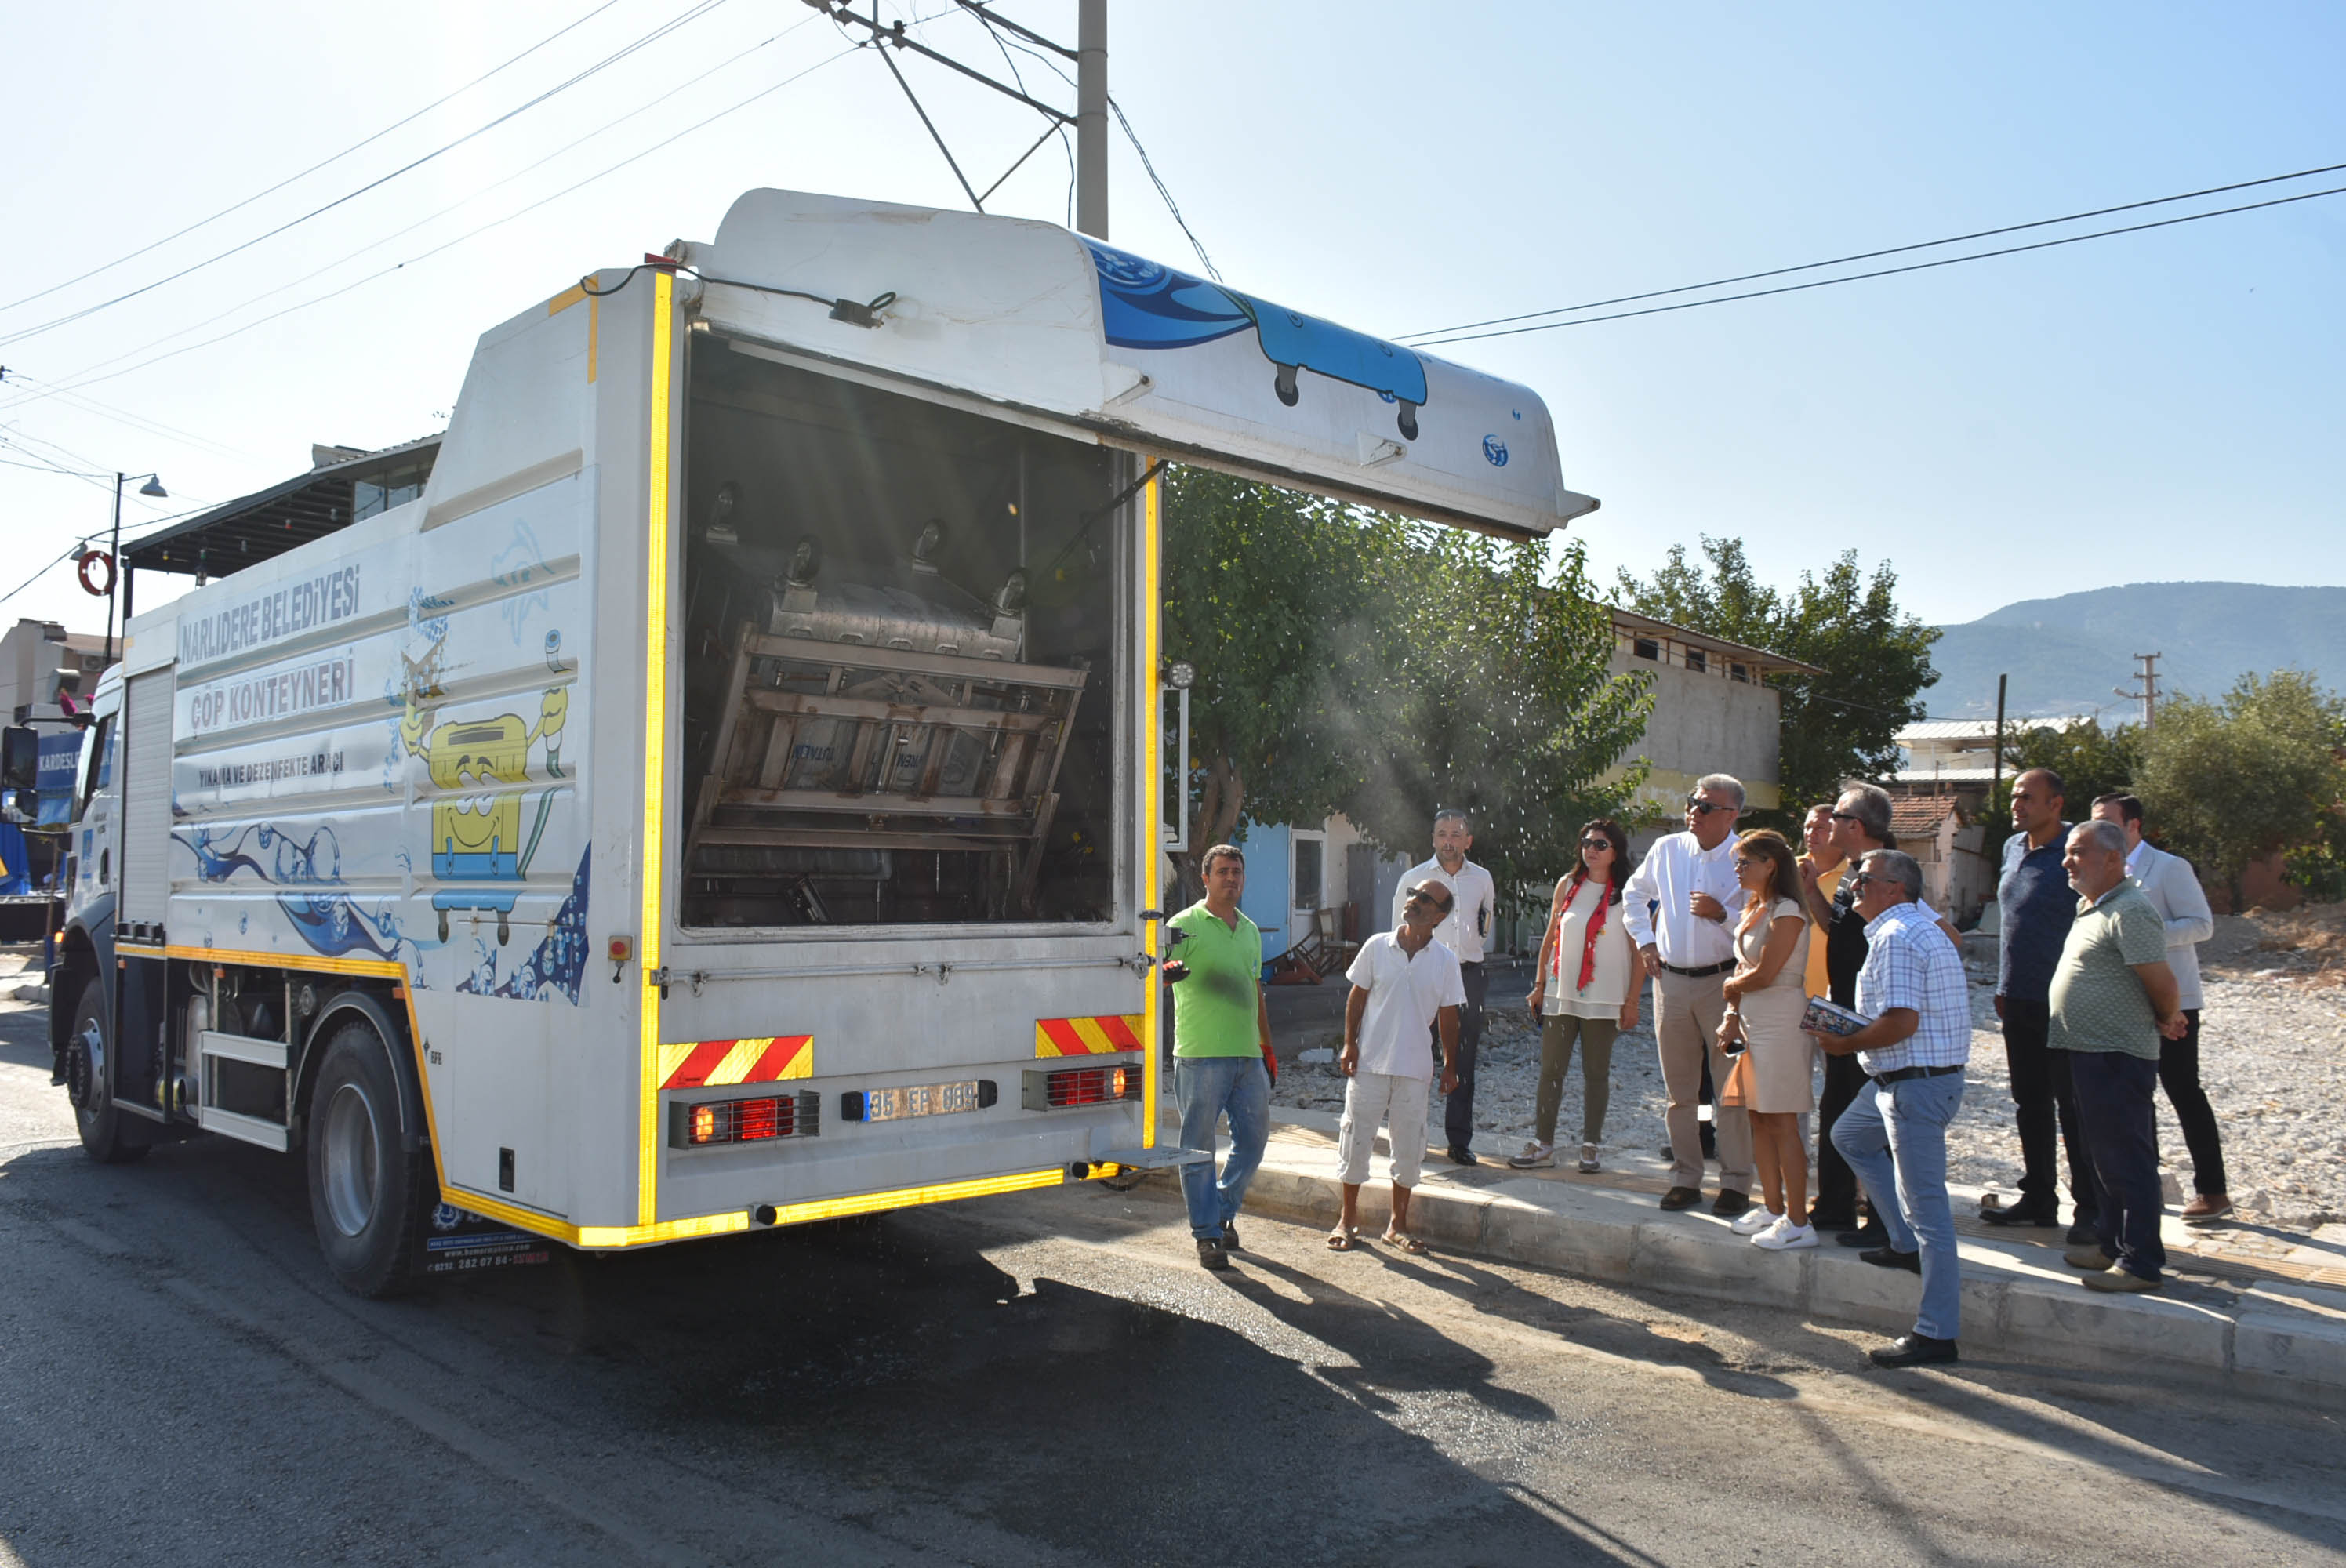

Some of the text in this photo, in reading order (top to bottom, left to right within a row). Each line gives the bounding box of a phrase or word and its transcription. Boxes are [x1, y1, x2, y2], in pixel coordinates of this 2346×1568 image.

[182, 564, 360, 665] NARLIDERE BELEDİYESİ
[229, 648, 354, 723] KONTEYNERİ
[38, 751, 80, 775] KARDEŞLE
[246, 756, 308, 783] DEZENFEKTE
[871, 1092, 894, 1117] 35
[908, 1089, 930, 1114] EP
[480, 1257, 492, 1267] 07
